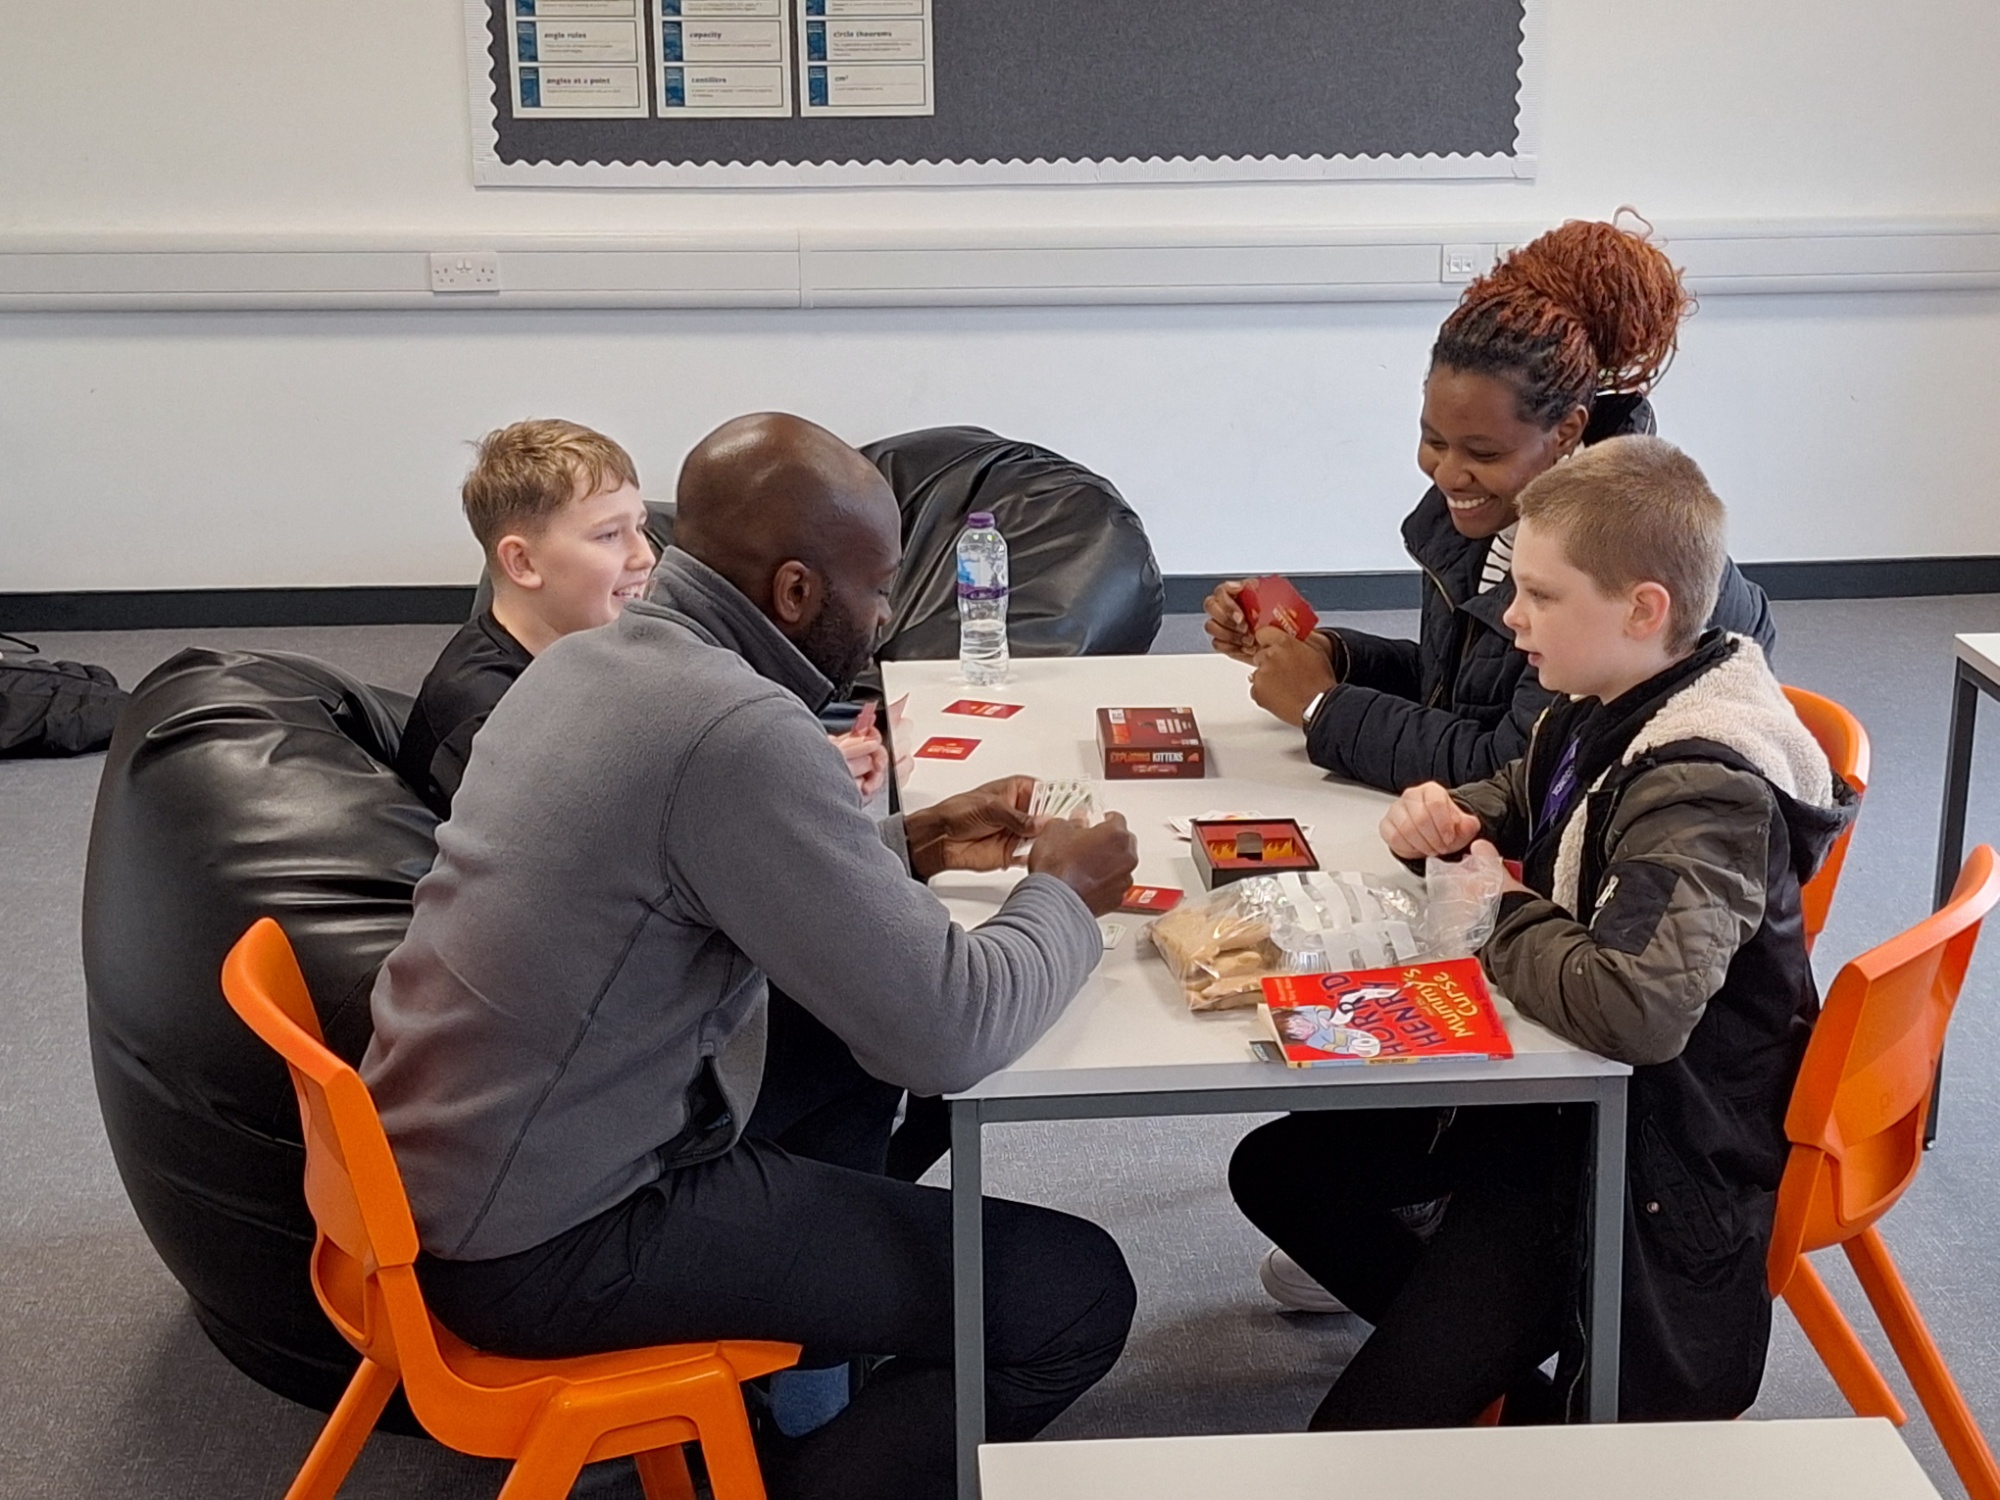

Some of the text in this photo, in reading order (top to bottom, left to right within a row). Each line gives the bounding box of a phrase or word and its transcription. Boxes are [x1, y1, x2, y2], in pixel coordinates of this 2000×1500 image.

[1152, 752, 1184, 762] KITTENS
[1403, 968, 1476, 1038] Mummy's
[1433, 971, 1478, 1017] Curse
